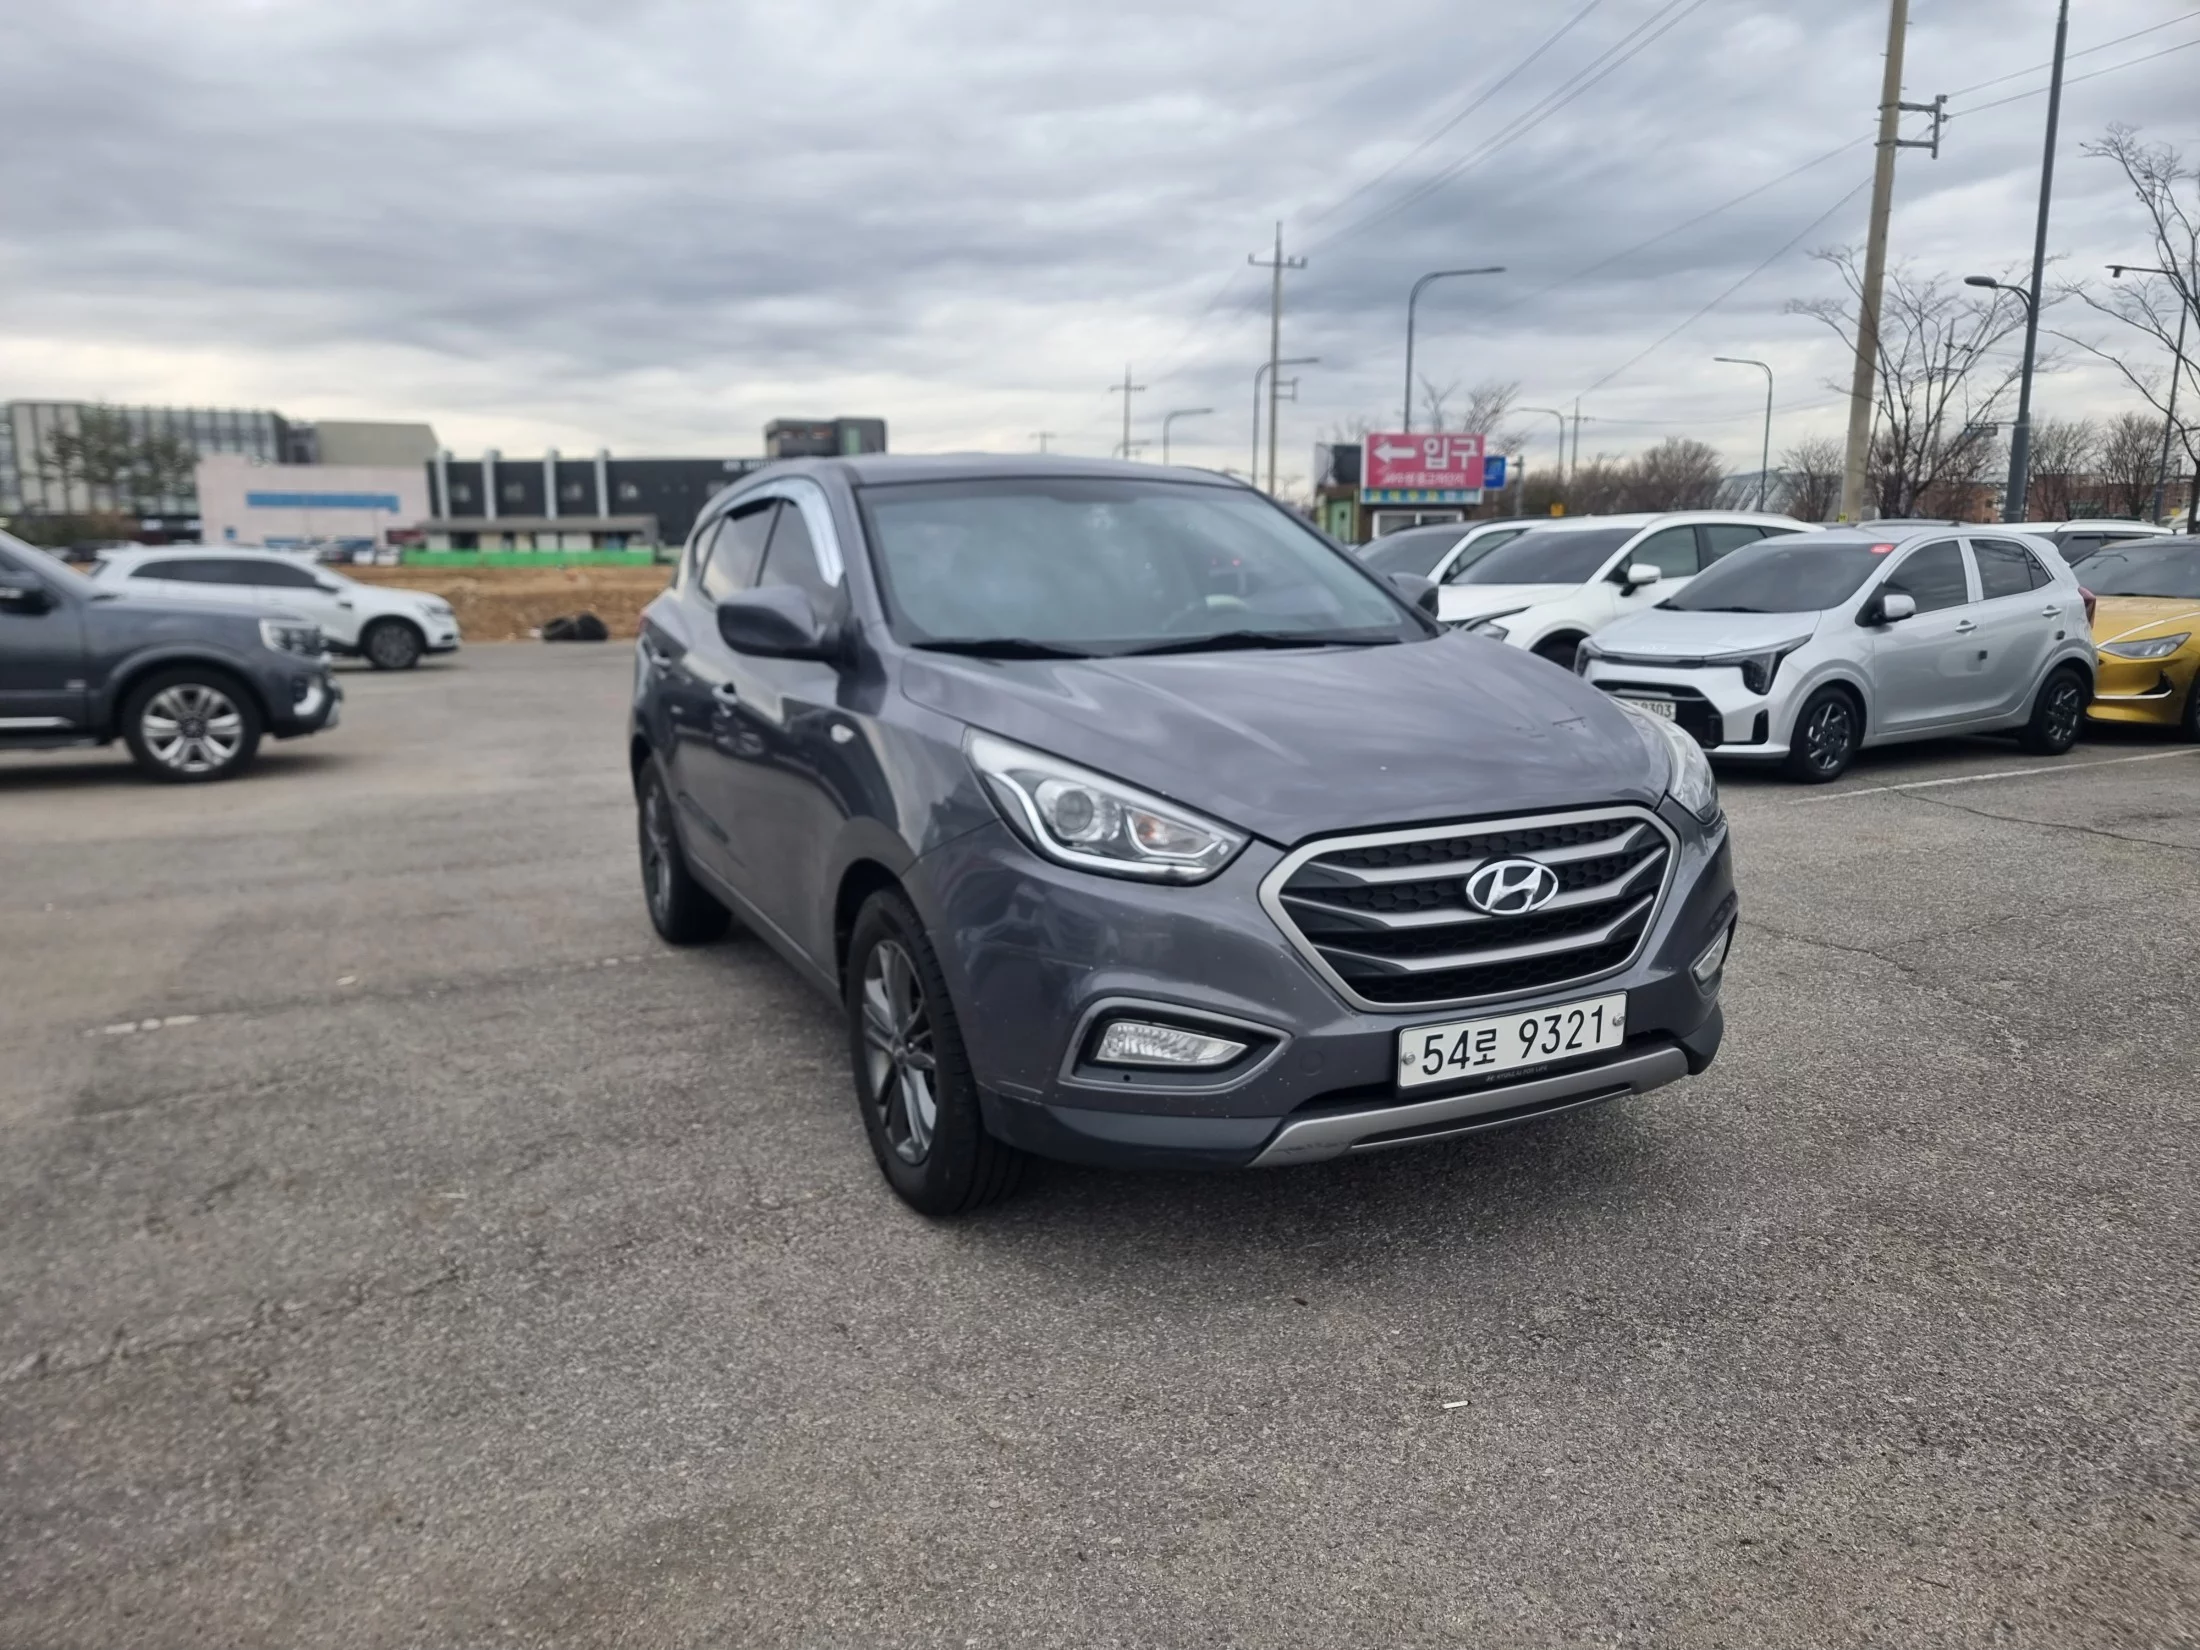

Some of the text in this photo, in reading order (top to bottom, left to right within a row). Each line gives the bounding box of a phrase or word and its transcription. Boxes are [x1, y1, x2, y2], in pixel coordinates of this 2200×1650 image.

[1423, 437, 1478, 470] 입구
[1422, 1004, 1603, 1076] 54로 9321
